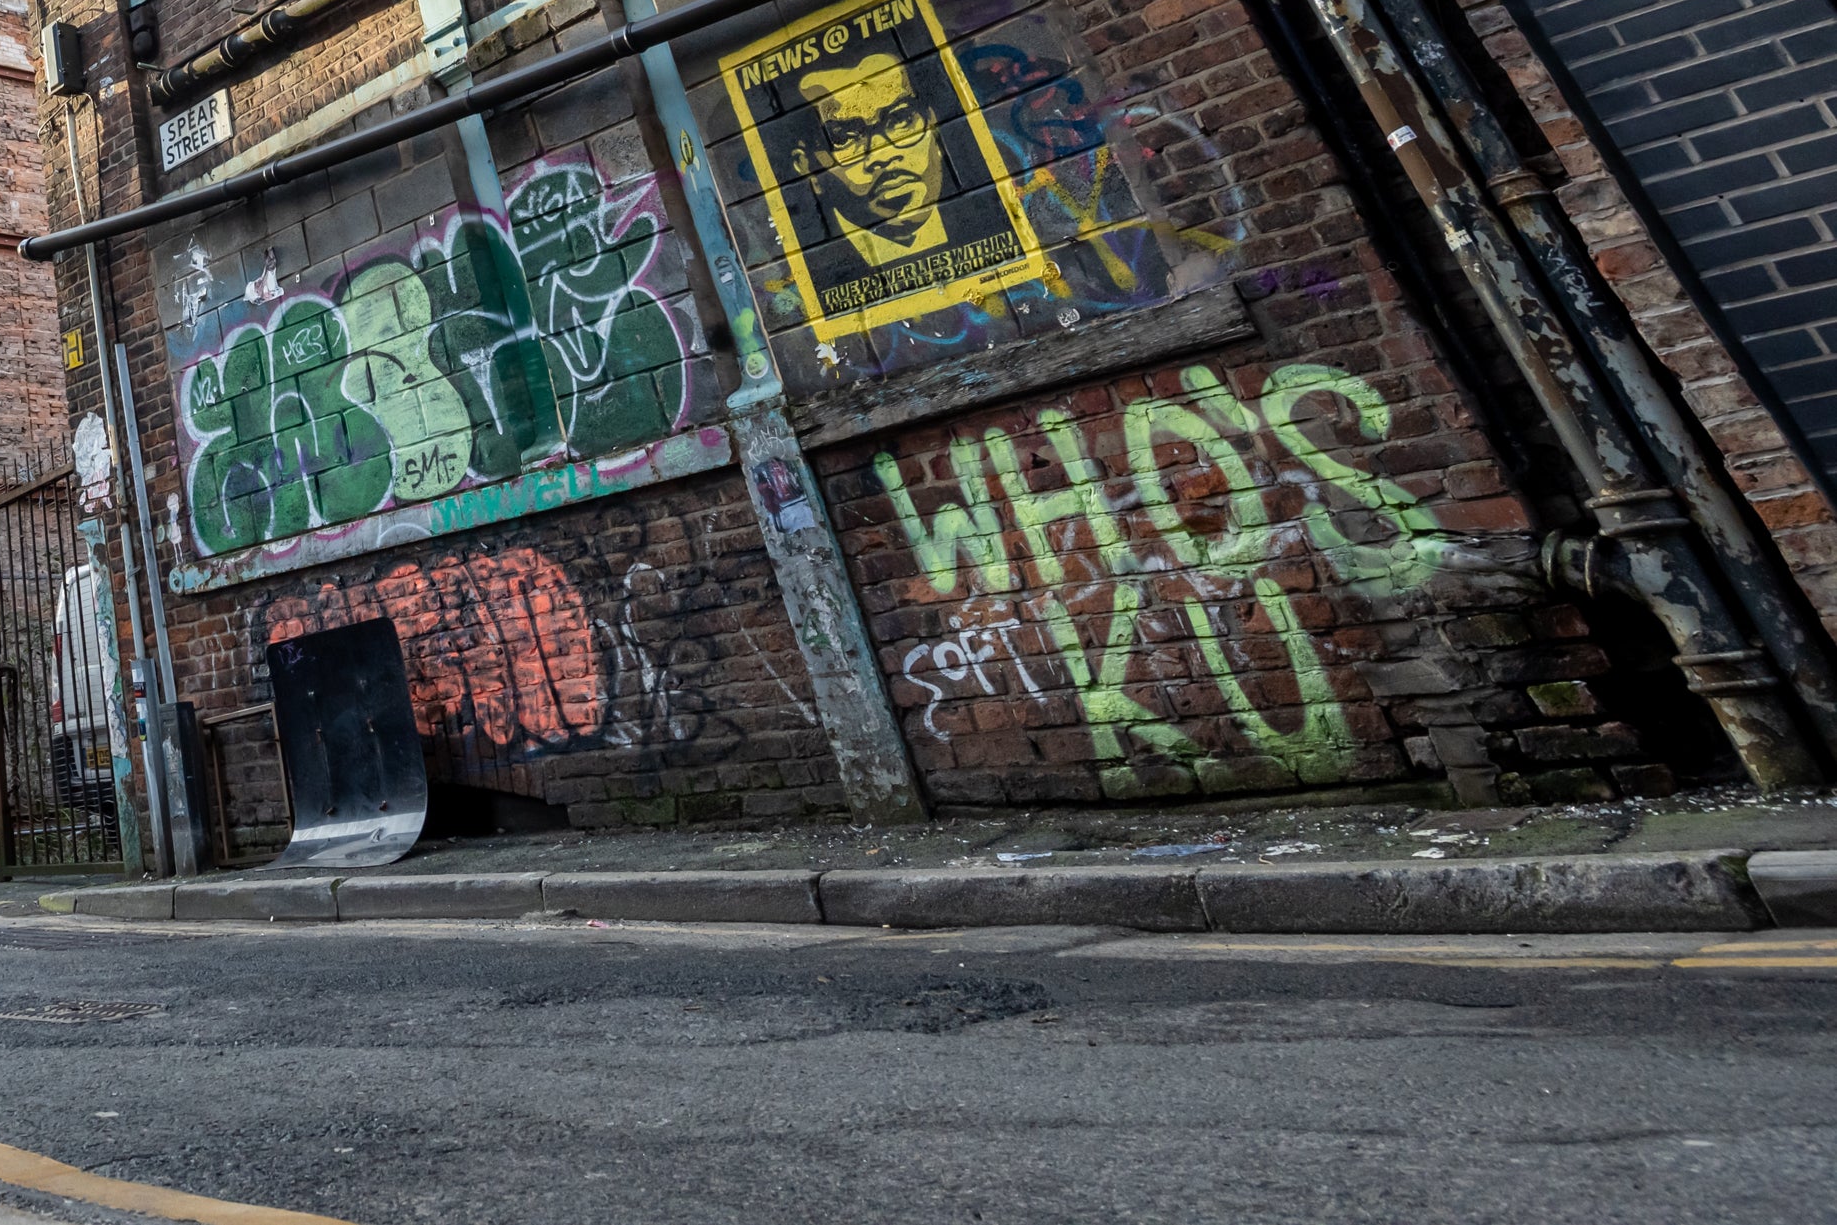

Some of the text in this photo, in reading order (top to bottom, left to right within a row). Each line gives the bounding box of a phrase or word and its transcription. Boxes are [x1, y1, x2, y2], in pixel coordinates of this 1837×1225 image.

[741, 36, 820, 91] NEWS
[166, 121, 216, 165] STREET
[167, 98, 220, 143] SPEAR
[822, 280, 860, 304] TRUE
[860, 262, 916, 294] POWER
[916, 252, 953, 278] LIES
[952, 231, 1014, 266] WITHIN
